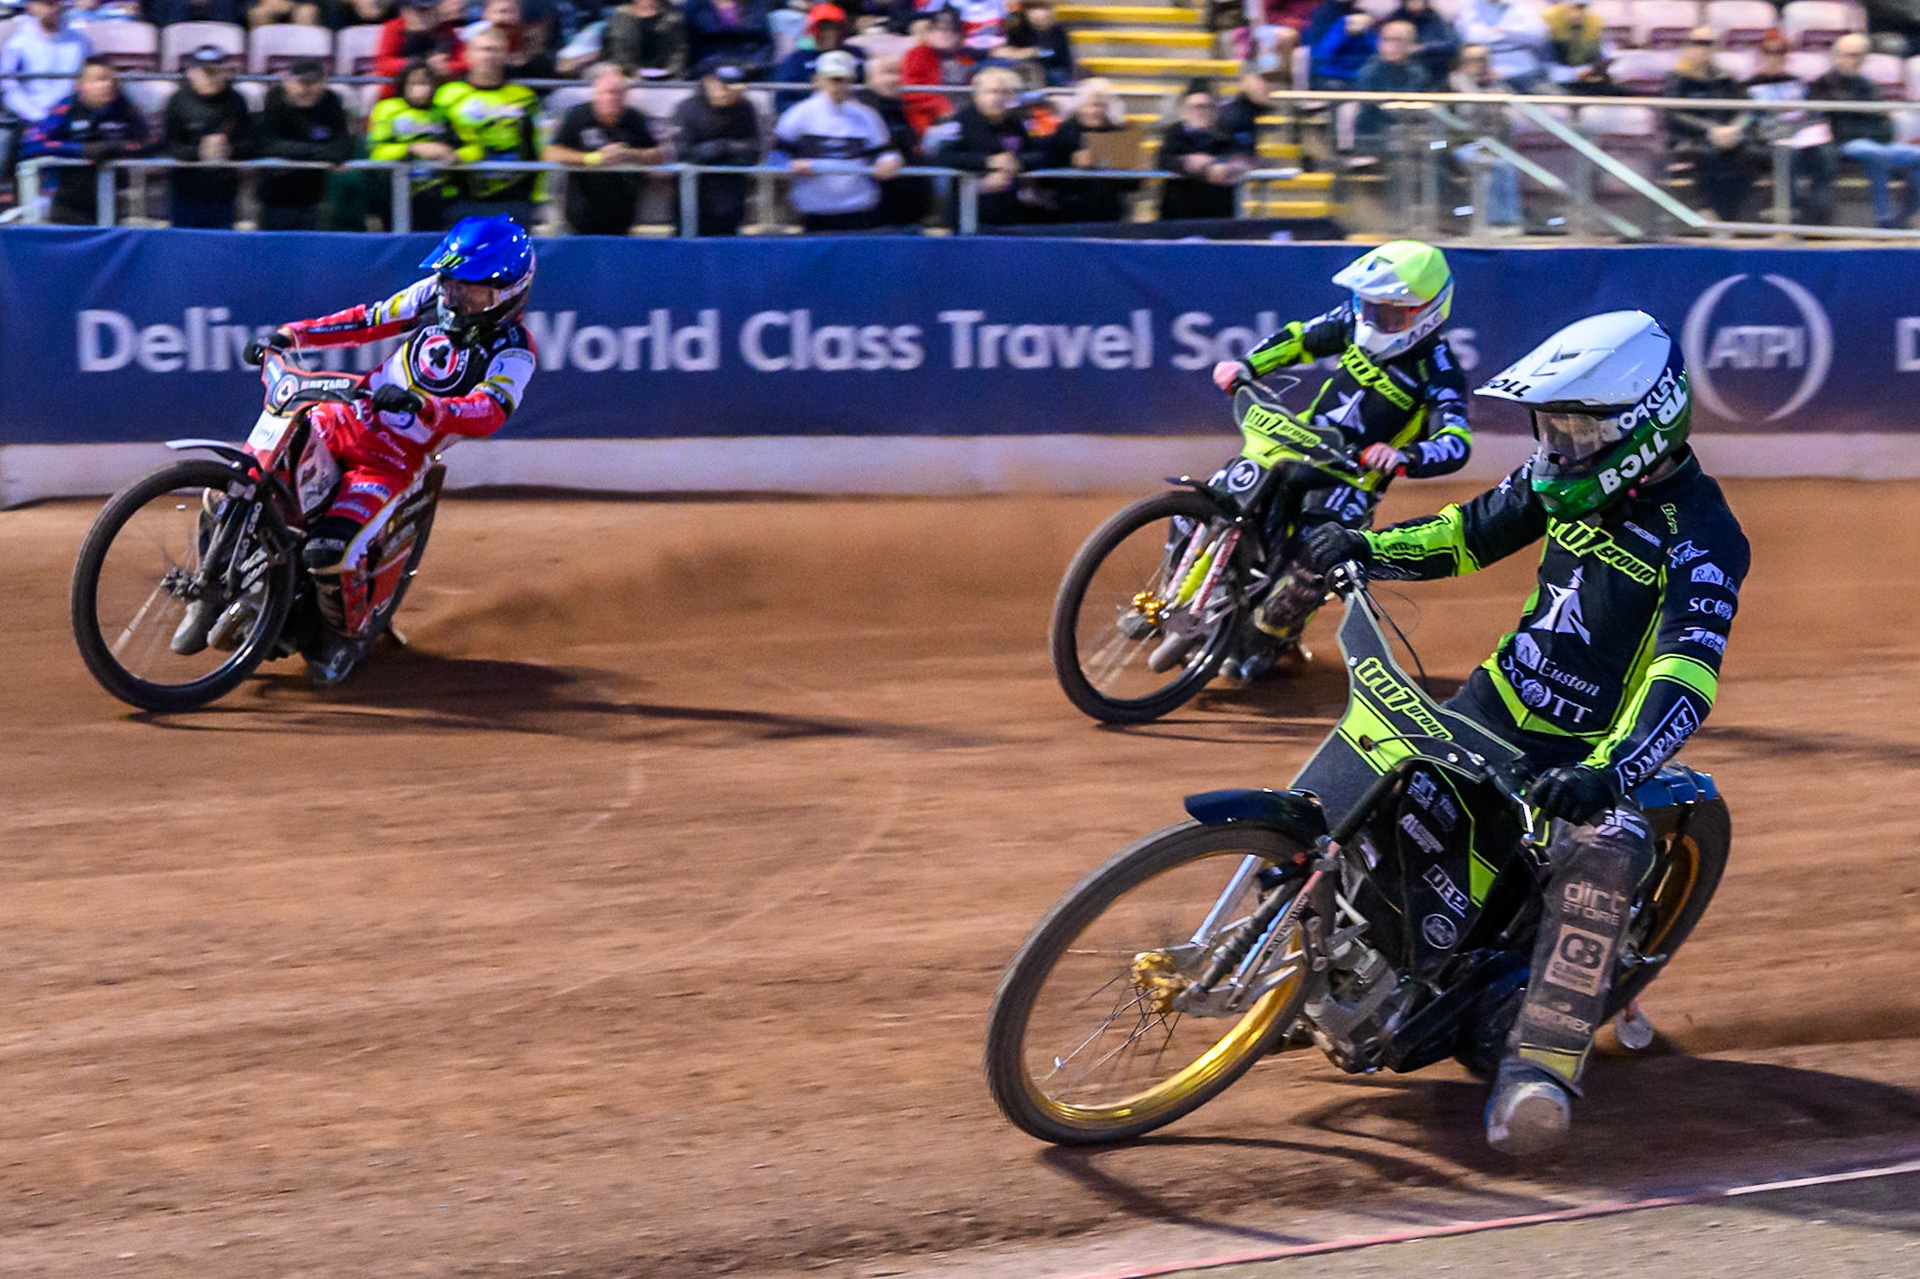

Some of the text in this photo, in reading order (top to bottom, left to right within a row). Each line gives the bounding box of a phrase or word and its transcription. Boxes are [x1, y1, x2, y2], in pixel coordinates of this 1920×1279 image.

[523, 308, 720, 373] World
[741, 308, 925, 373] Class
[939, 308, 1154, 371] Travel
[1538, 656, 1600, 697] Euston
[1562, 902, 1621, 926] STORE
[1564, 881, 1627, 914] dirt
